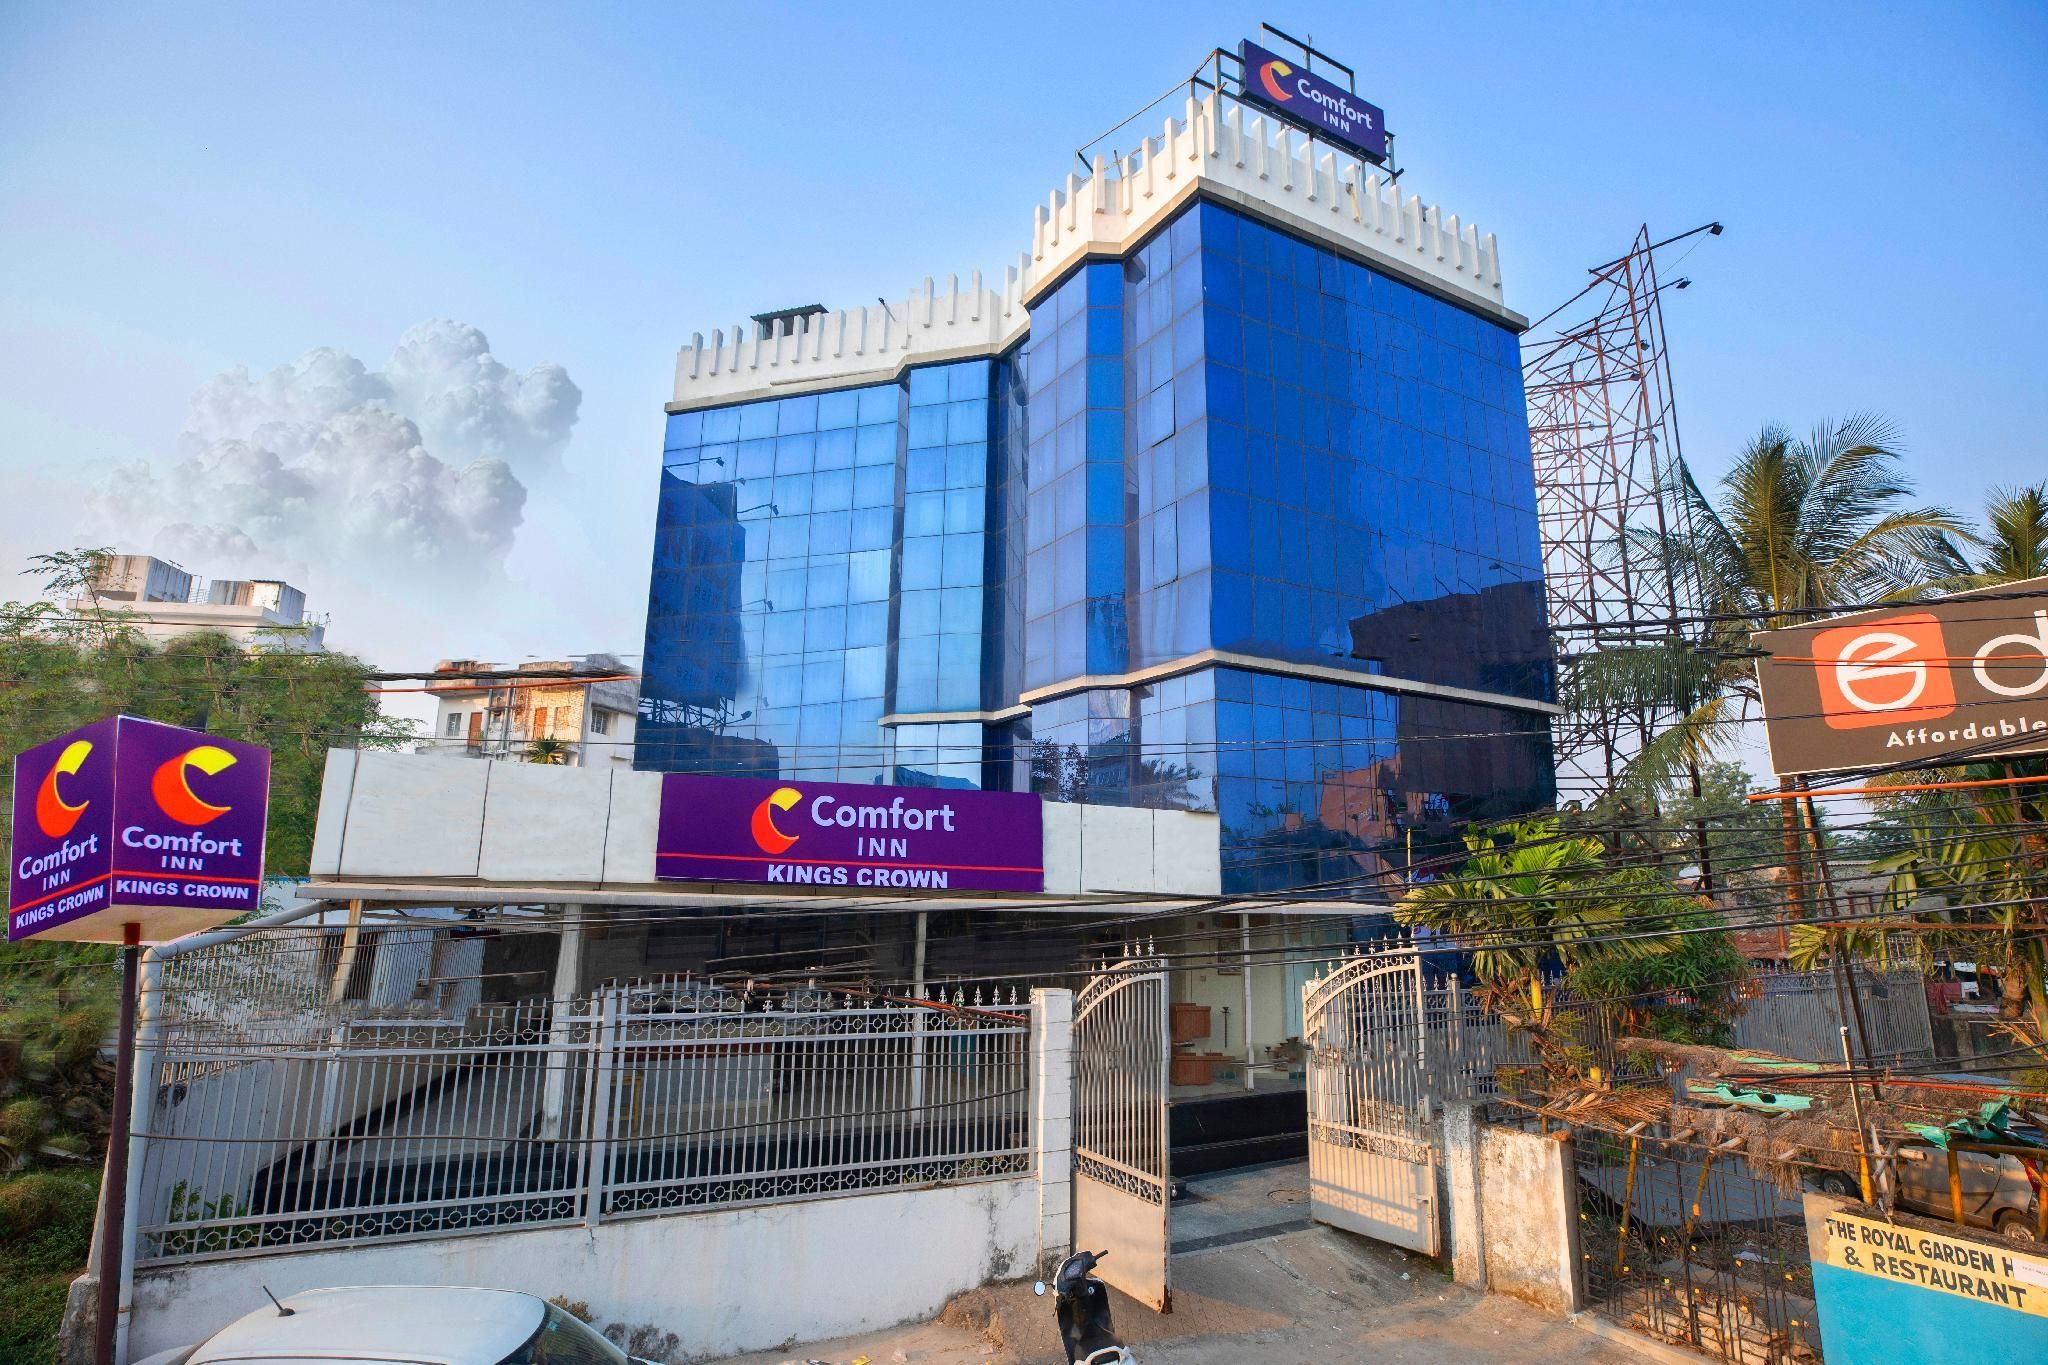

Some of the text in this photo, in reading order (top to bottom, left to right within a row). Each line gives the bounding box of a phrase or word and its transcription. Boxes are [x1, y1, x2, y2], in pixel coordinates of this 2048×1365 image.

[1297, 78, 1373, 130] Comfort
[1323, 110, 1350, 133] INN
[1886, 716, 2047, 748] Affordable
[811, 795, 955, 832] Comfort
[19, 833, 98, 880] Comfort
[122, 826, 242, 857] Comfort
[857, 837, 907, 858] INN
[161, 855, 203, 871] INN
[767, 864, 948, 889] KINGS CROWN
[43, 868, 71, 892] INN
[116, 880, 249, 899] KINGS CROWN
[16, 885, 104, 929] KINGS CROWN
[1826, 1218, 1857, 1241] THE
[1861, 1226, 1916, 1255] ROYAL
[1918, 1239, 1996, 1274] GARDEN
[1844, 1246, 2027, 1308] & RESTAURANT
